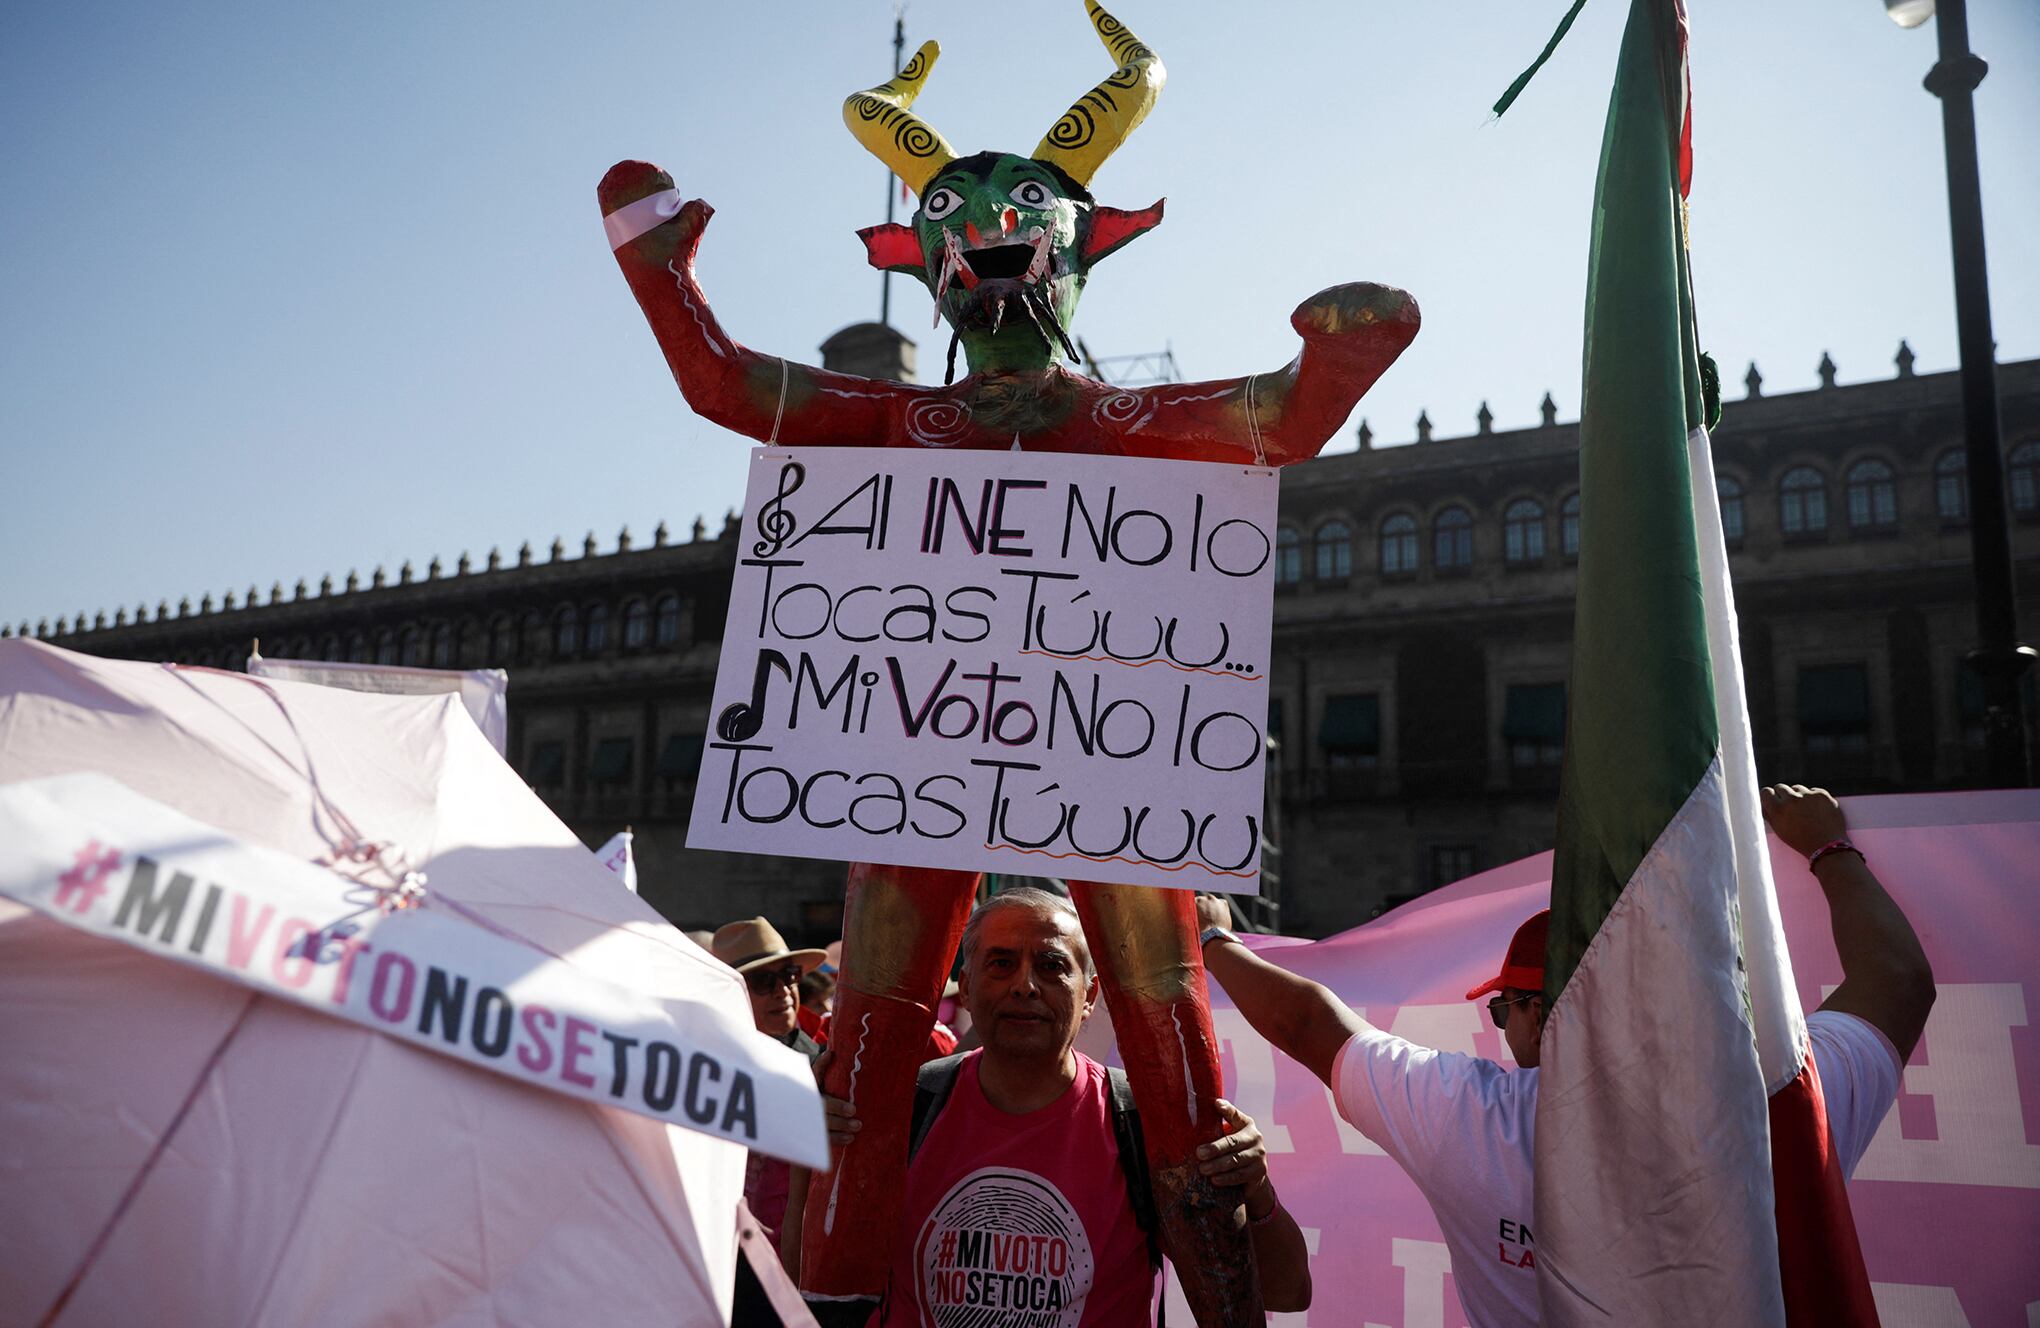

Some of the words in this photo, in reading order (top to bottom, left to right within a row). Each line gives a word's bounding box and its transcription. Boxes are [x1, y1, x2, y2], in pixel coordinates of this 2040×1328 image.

[920, 477, 1048, 557] INE
[1061, 483, 1173, 565] No
[741, 559, 997, 644] Tocas
[788, 651, 879, 734] Mi
[885, 656, 1039, 746] Voto
[1046, 670, 1155, 758] No
[709, 742, 967, 839] Tocas
[935, 1271, 1062, 1313] NOSETOCA
[938, 1229, 1067, 1277] #MIVOTO
